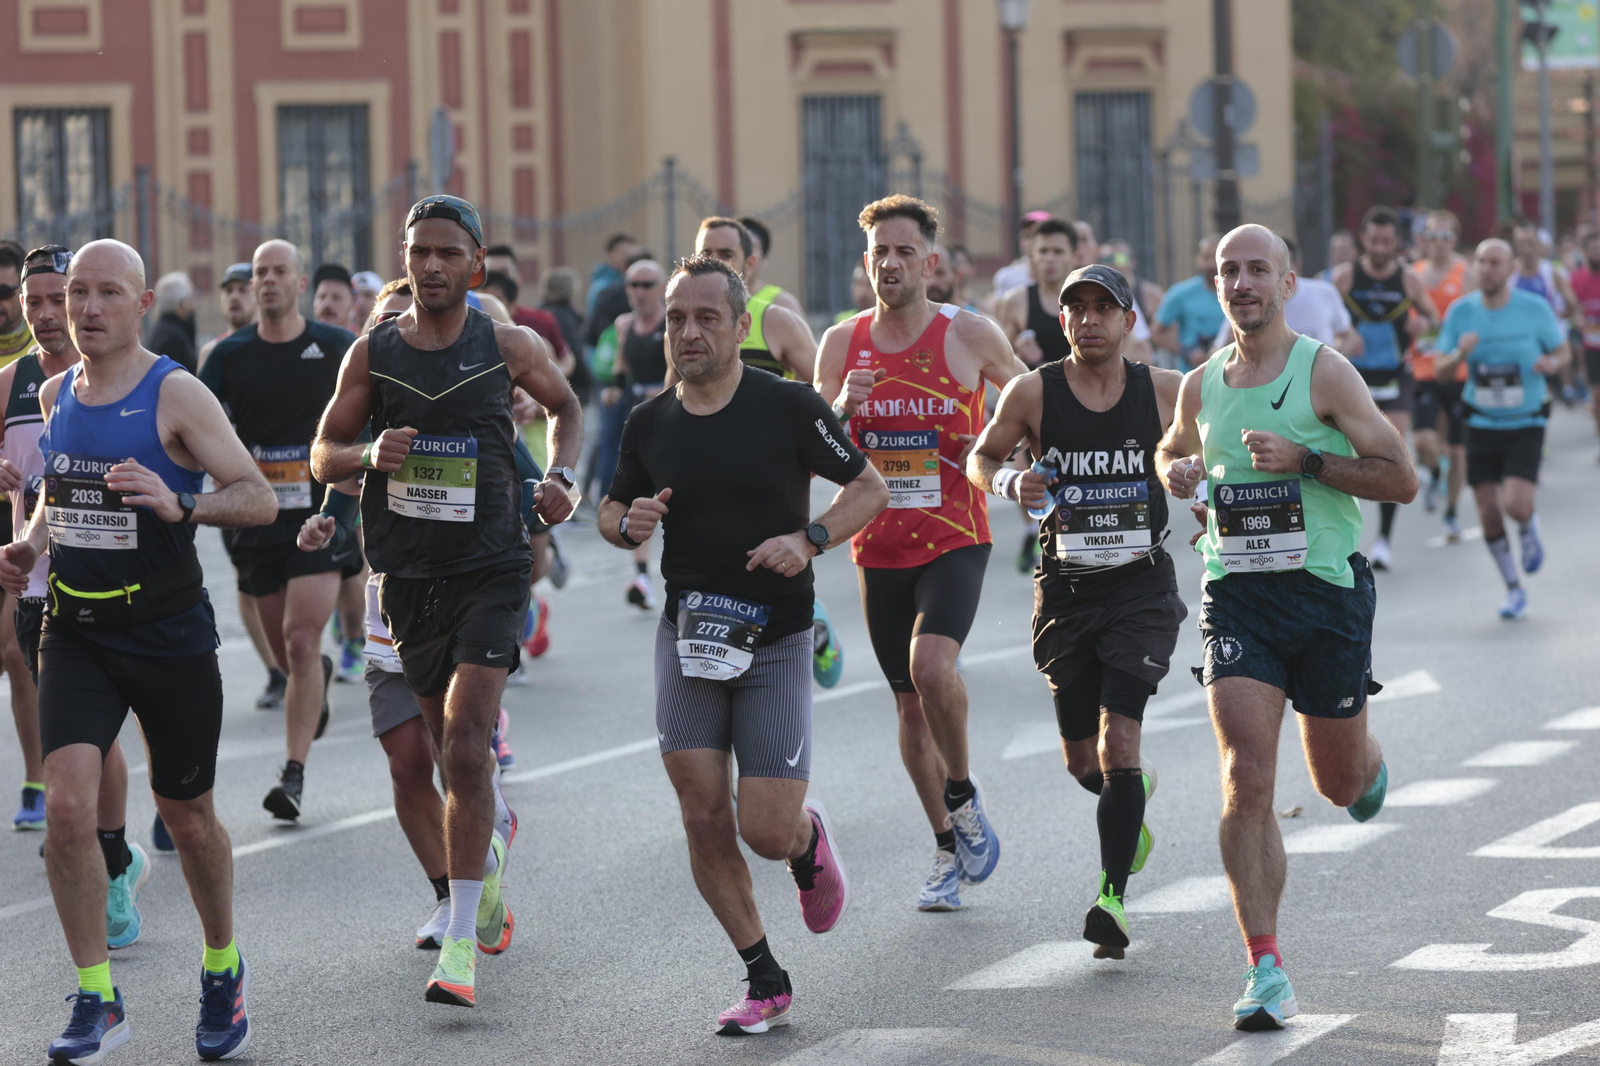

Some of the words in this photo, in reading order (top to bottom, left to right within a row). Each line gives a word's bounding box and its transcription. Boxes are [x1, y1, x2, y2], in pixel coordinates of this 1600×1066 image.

[412, 440, 466, 454] ZURICH
[814, 418, 850, 462] salomon
[880, 435, 928, 447] ZURICH
[72, 460, 118, 474] ZURIC
[883, 460, 910, 472] 3799
[1056, 450, 1145, 476] VIKRAM
[412, 466, 444, 480] 1327
[884, 478, 921, 489] ARTÍNEZ
[71, 488, 103, 504] 2033
[406, 487, 448, 500] NASSER
[1086, 486, 1137, 500] ZURICH
[1236, 486, 1288, 501] ZURICH
[51, 510, 79, 524] JESUS
[82, 513, 128, 527] ASENSIO
[1088, 514, 1118, 527] 1945
[1241, 515, 1271, 530] 1969
[1084, 535, 1124, 546] VIKRAM
[1246, 538, 1270, 550] ALEX
[703, 596, 757, 618] ZURICH
[696, 622, 730, 638] 2772
[689, 643, 729, 658] THIERRY
